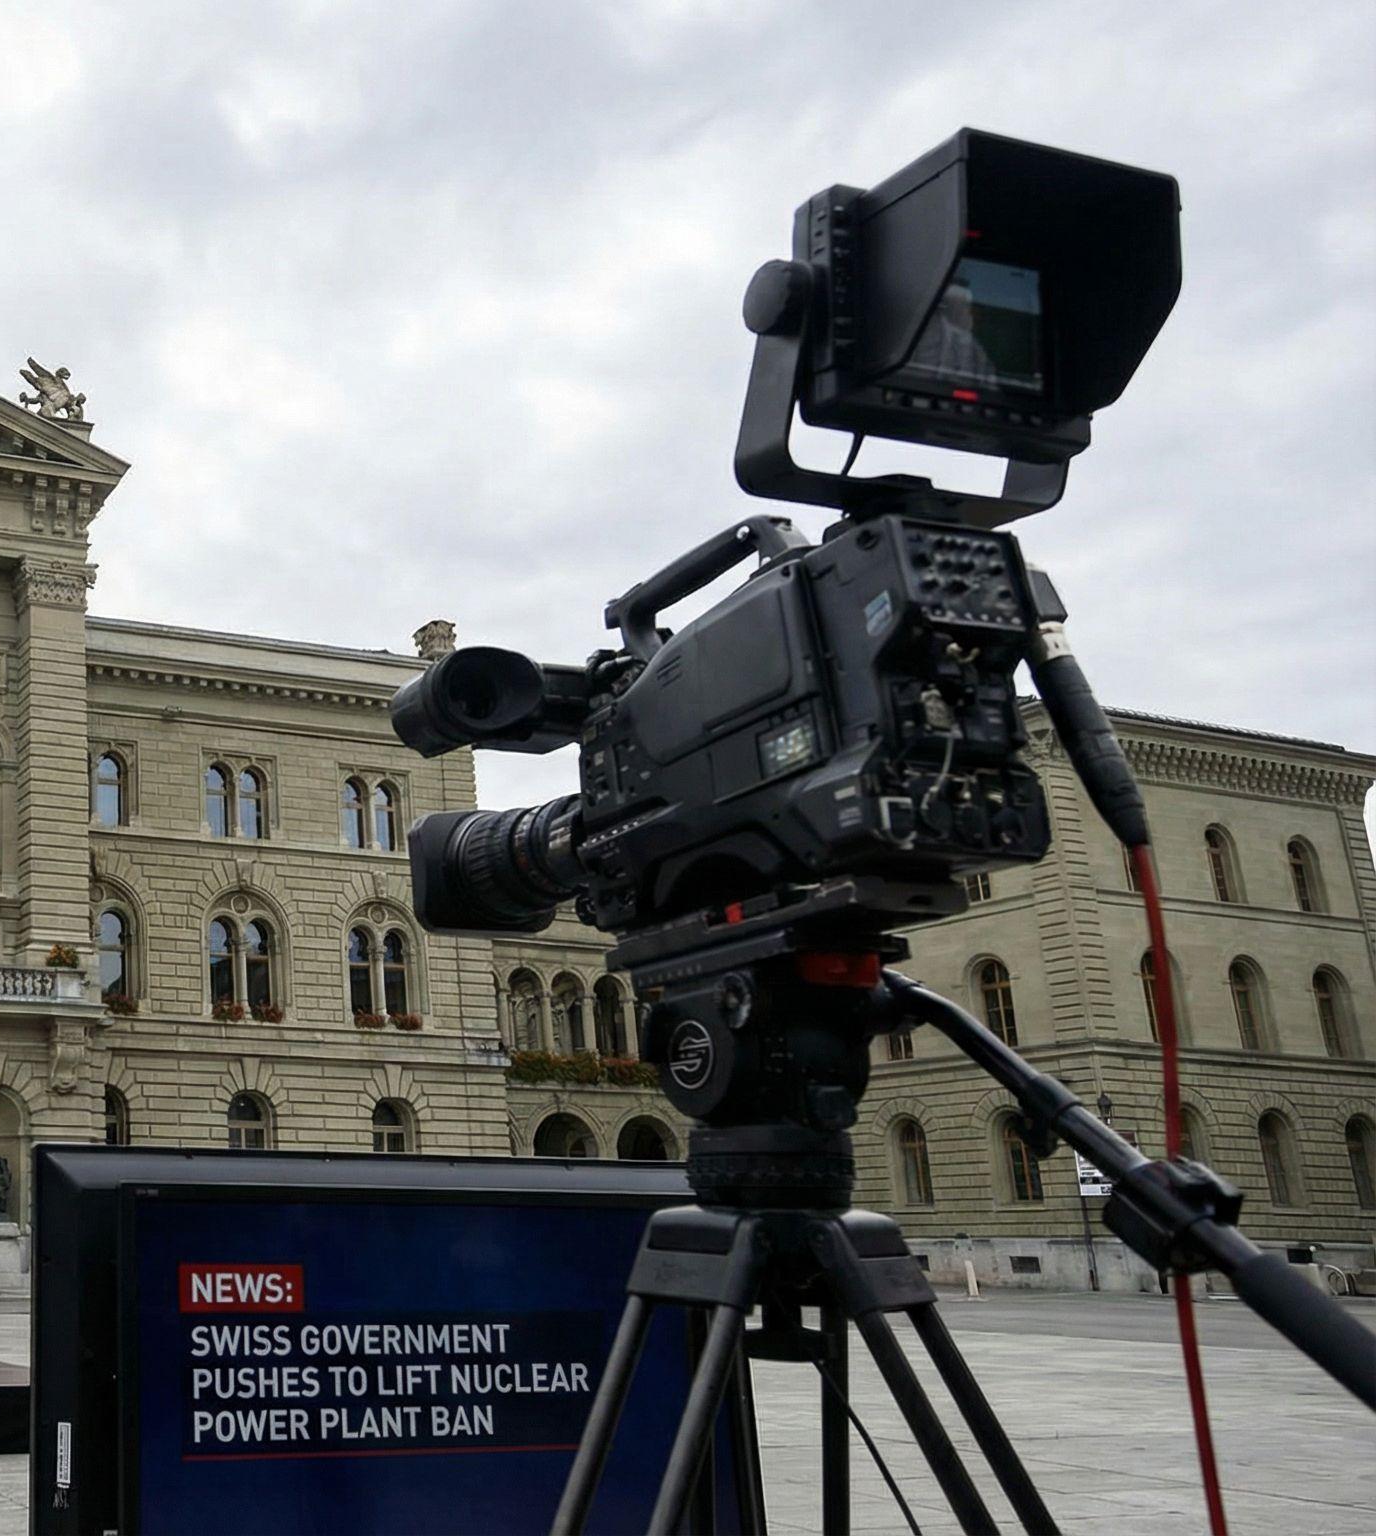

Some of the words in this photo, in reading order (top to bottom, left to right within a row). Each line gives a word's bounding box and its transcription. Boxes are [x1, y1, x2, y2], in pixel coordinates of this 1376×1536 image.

[190, 1273, 293, 1304] NEWS:
[190, 1325, 292, 1357] SWISS
[300, 1323, 511, 1356] GOVERNMENT
[192, 1366, 321, 1400] PUSHES
[328, 1366, 368, 1397] TO
[377, 1365, 442, 1396] LIFT
[450, 1362, 590, 1395] NUCLEAR
[193, 1408, 311, 1444] POWER
[320, 1406, 423, 1440] PLANT
[431, 1404, 495, 1437] BAN
